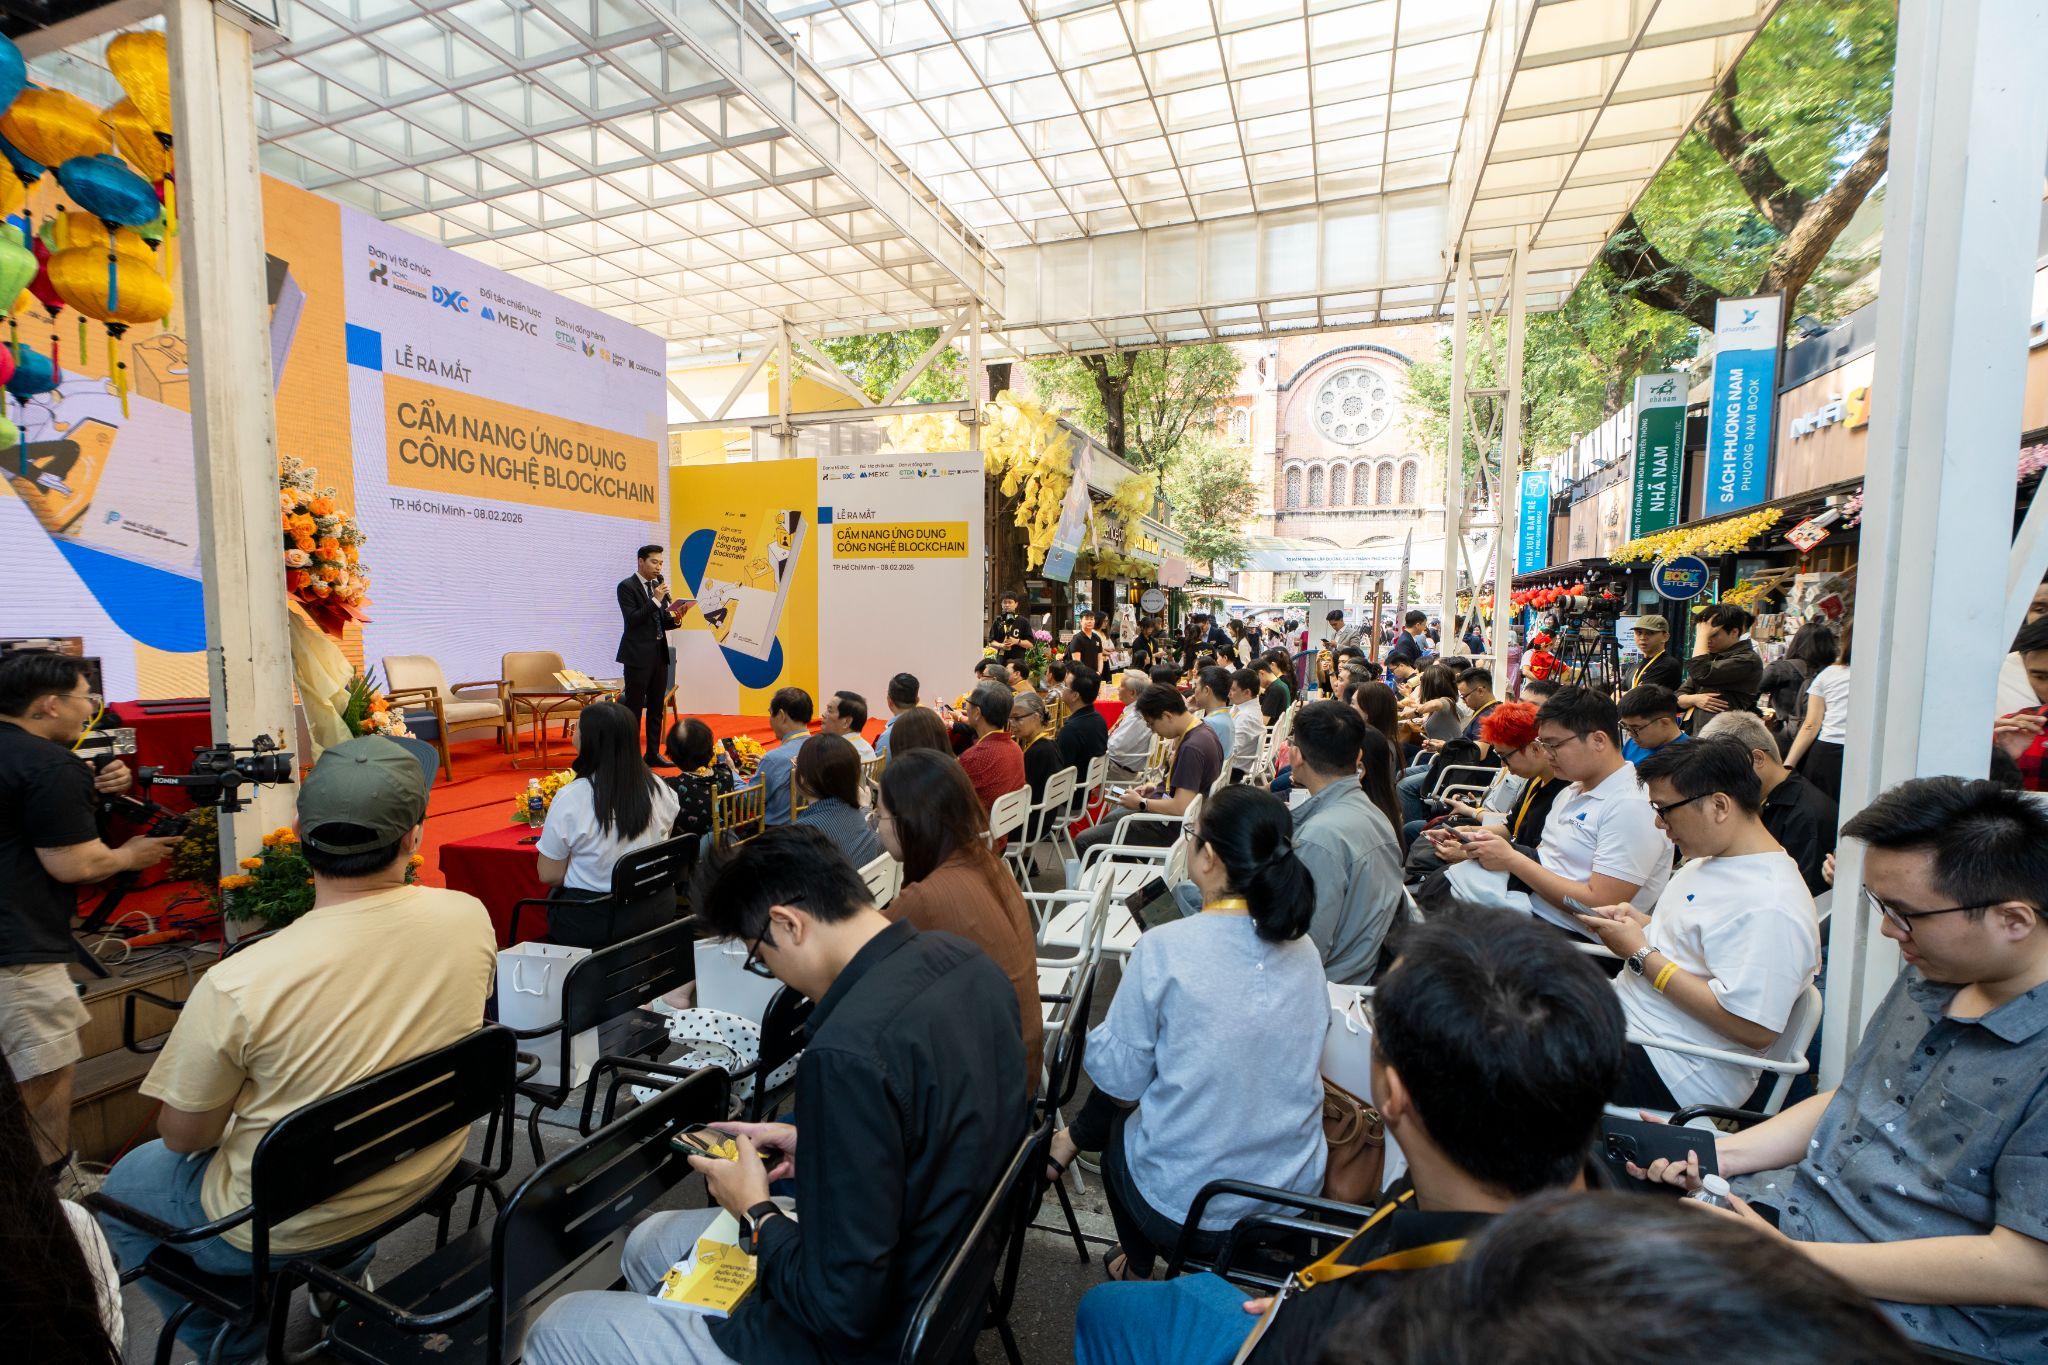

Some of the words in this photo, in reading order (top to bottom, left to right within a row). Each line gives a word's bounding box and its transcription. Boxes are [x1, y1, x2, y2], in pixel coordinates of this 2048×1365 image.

[368, 245, 388, 260] Đơn
[389, 254, 397, 266] vị
[409, 263, 431, 277] chức
[431, 285, 469, 313] DXC
[497, 311, 538, 337] MEXC
[395, 344, 414, 369] LỄ
[416, 355, 438, 376] RA
[440, 358, 472, 384] MẮT
[1730, 367, 1744, 401] NAM
[1749, 379, 1760, 411] BOOK
[397, 398, 457, 437] CẨM
[462, 416, 527, 450] NANG
[530, 425, 574, 460] ỨNG
[576, 442, 627, 472] DỤNG
[1723, 404, 1741, 462] PHƯƠNG
[1746, 415, 1757, 440] NAM
[398, 435, 475, 474] CÔNG
[480, 453, 540, 490] NGHỆ
[543, 465, 655, 505] BLOCKCHAIN
[1652, 446, 1669, 478] NAM
[1741, 443, 1754, 491] PHUONG
[1648, 481, 1666, 512] NHÃ
[1719, 463, 1737, 503] SÁCH
[390, 498, 406, 511] TP.
[406, 499, 422, 512] Hồ
[423, 500, 441, 515] Chí
[441, 503, 466, 518] Minh
[473, 509, 523, 523] 08.02.2026
[847, 511, 858, 519] RA
[837, 526, 860, 540] CẨM
[861, 529, 891, 539] NANG
[891, 527, 914, 539] ỨNG
[916, 529, 946, 541] DỤNG
[837, 541, 867, 552] CÔNG
[868, 540, 896, 554] NGHỆ
[898, 541, 965, 552] BLOCKCHAIN
[1664, 570, 1699, 582] BOOK
[152, 777, 179, 785] RONIN
